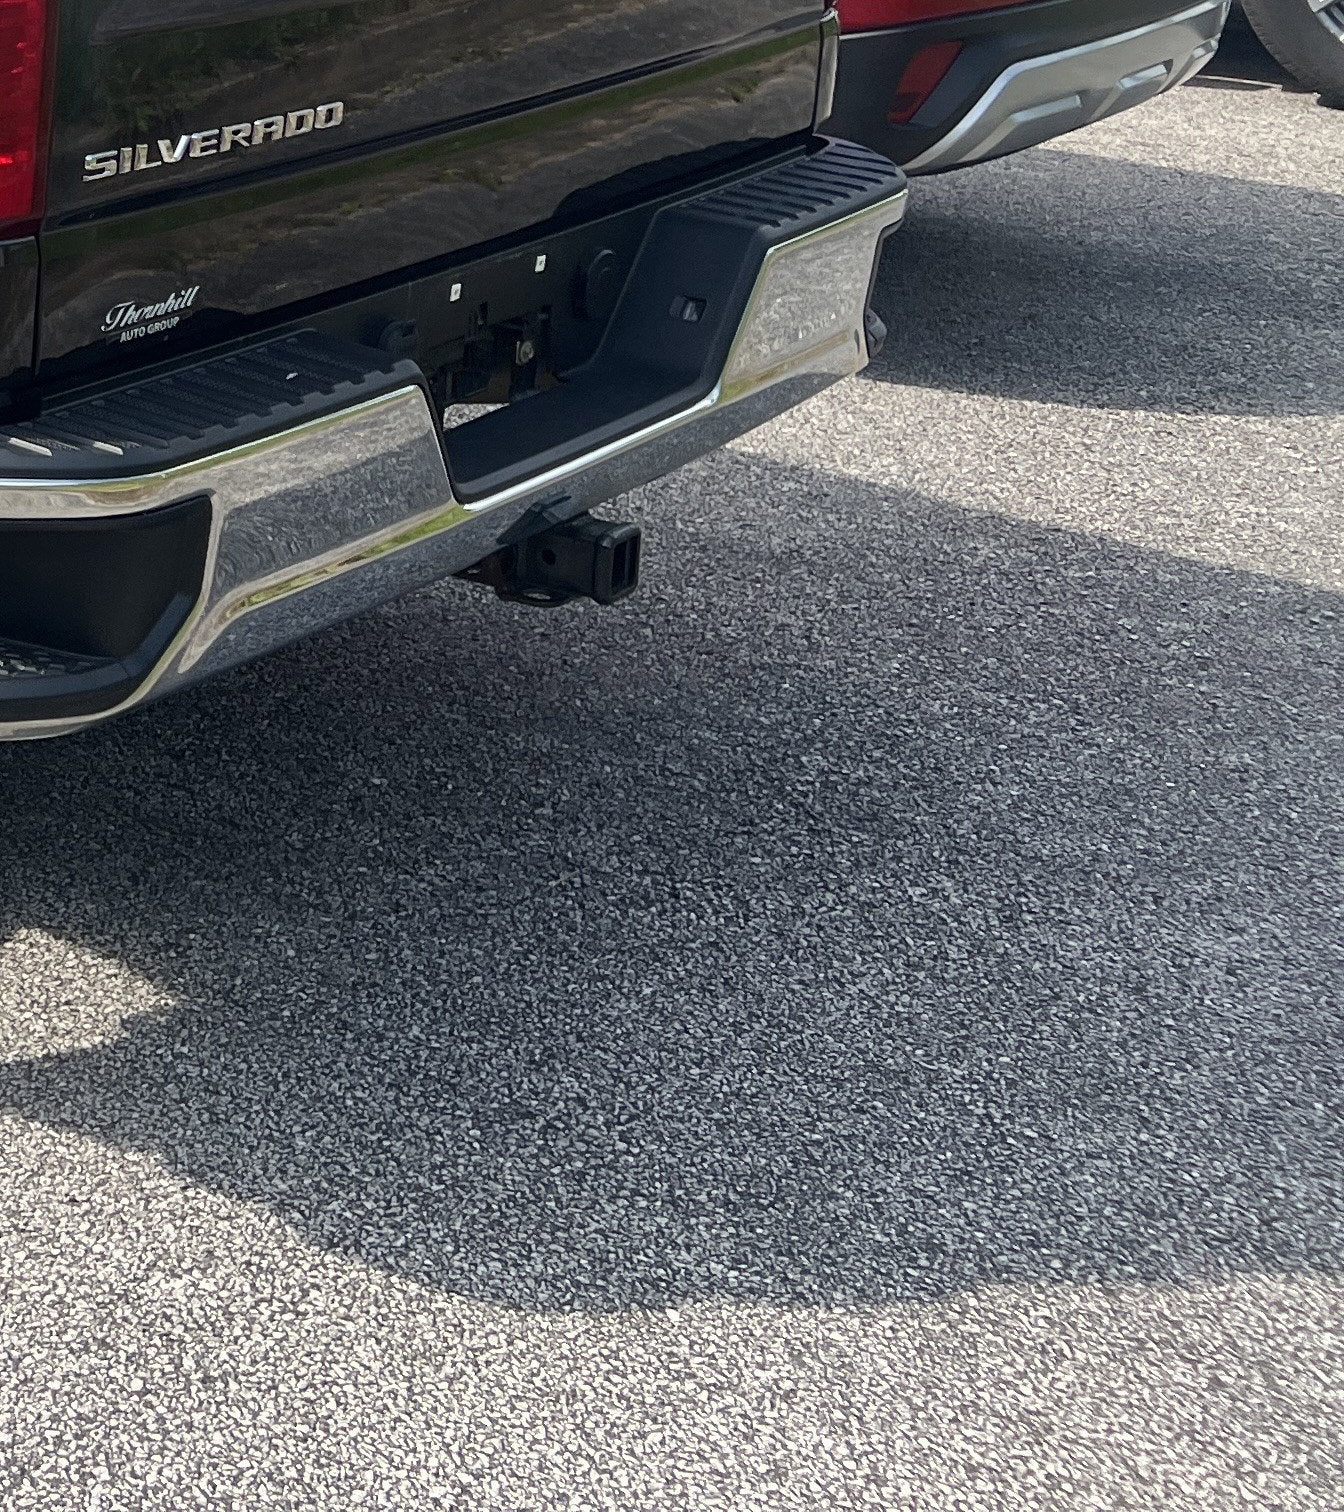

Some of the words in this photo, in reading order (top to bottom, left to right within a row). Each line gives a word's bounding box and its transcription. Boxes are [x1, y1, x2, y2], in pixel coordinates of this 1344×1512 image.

[82, 101, 344, 182] SILVERADO
[100, 285, 200, 332] Thornhill
[119, 326, 146, 343] AUTO
[147, 316, 180, 335] GROUP
